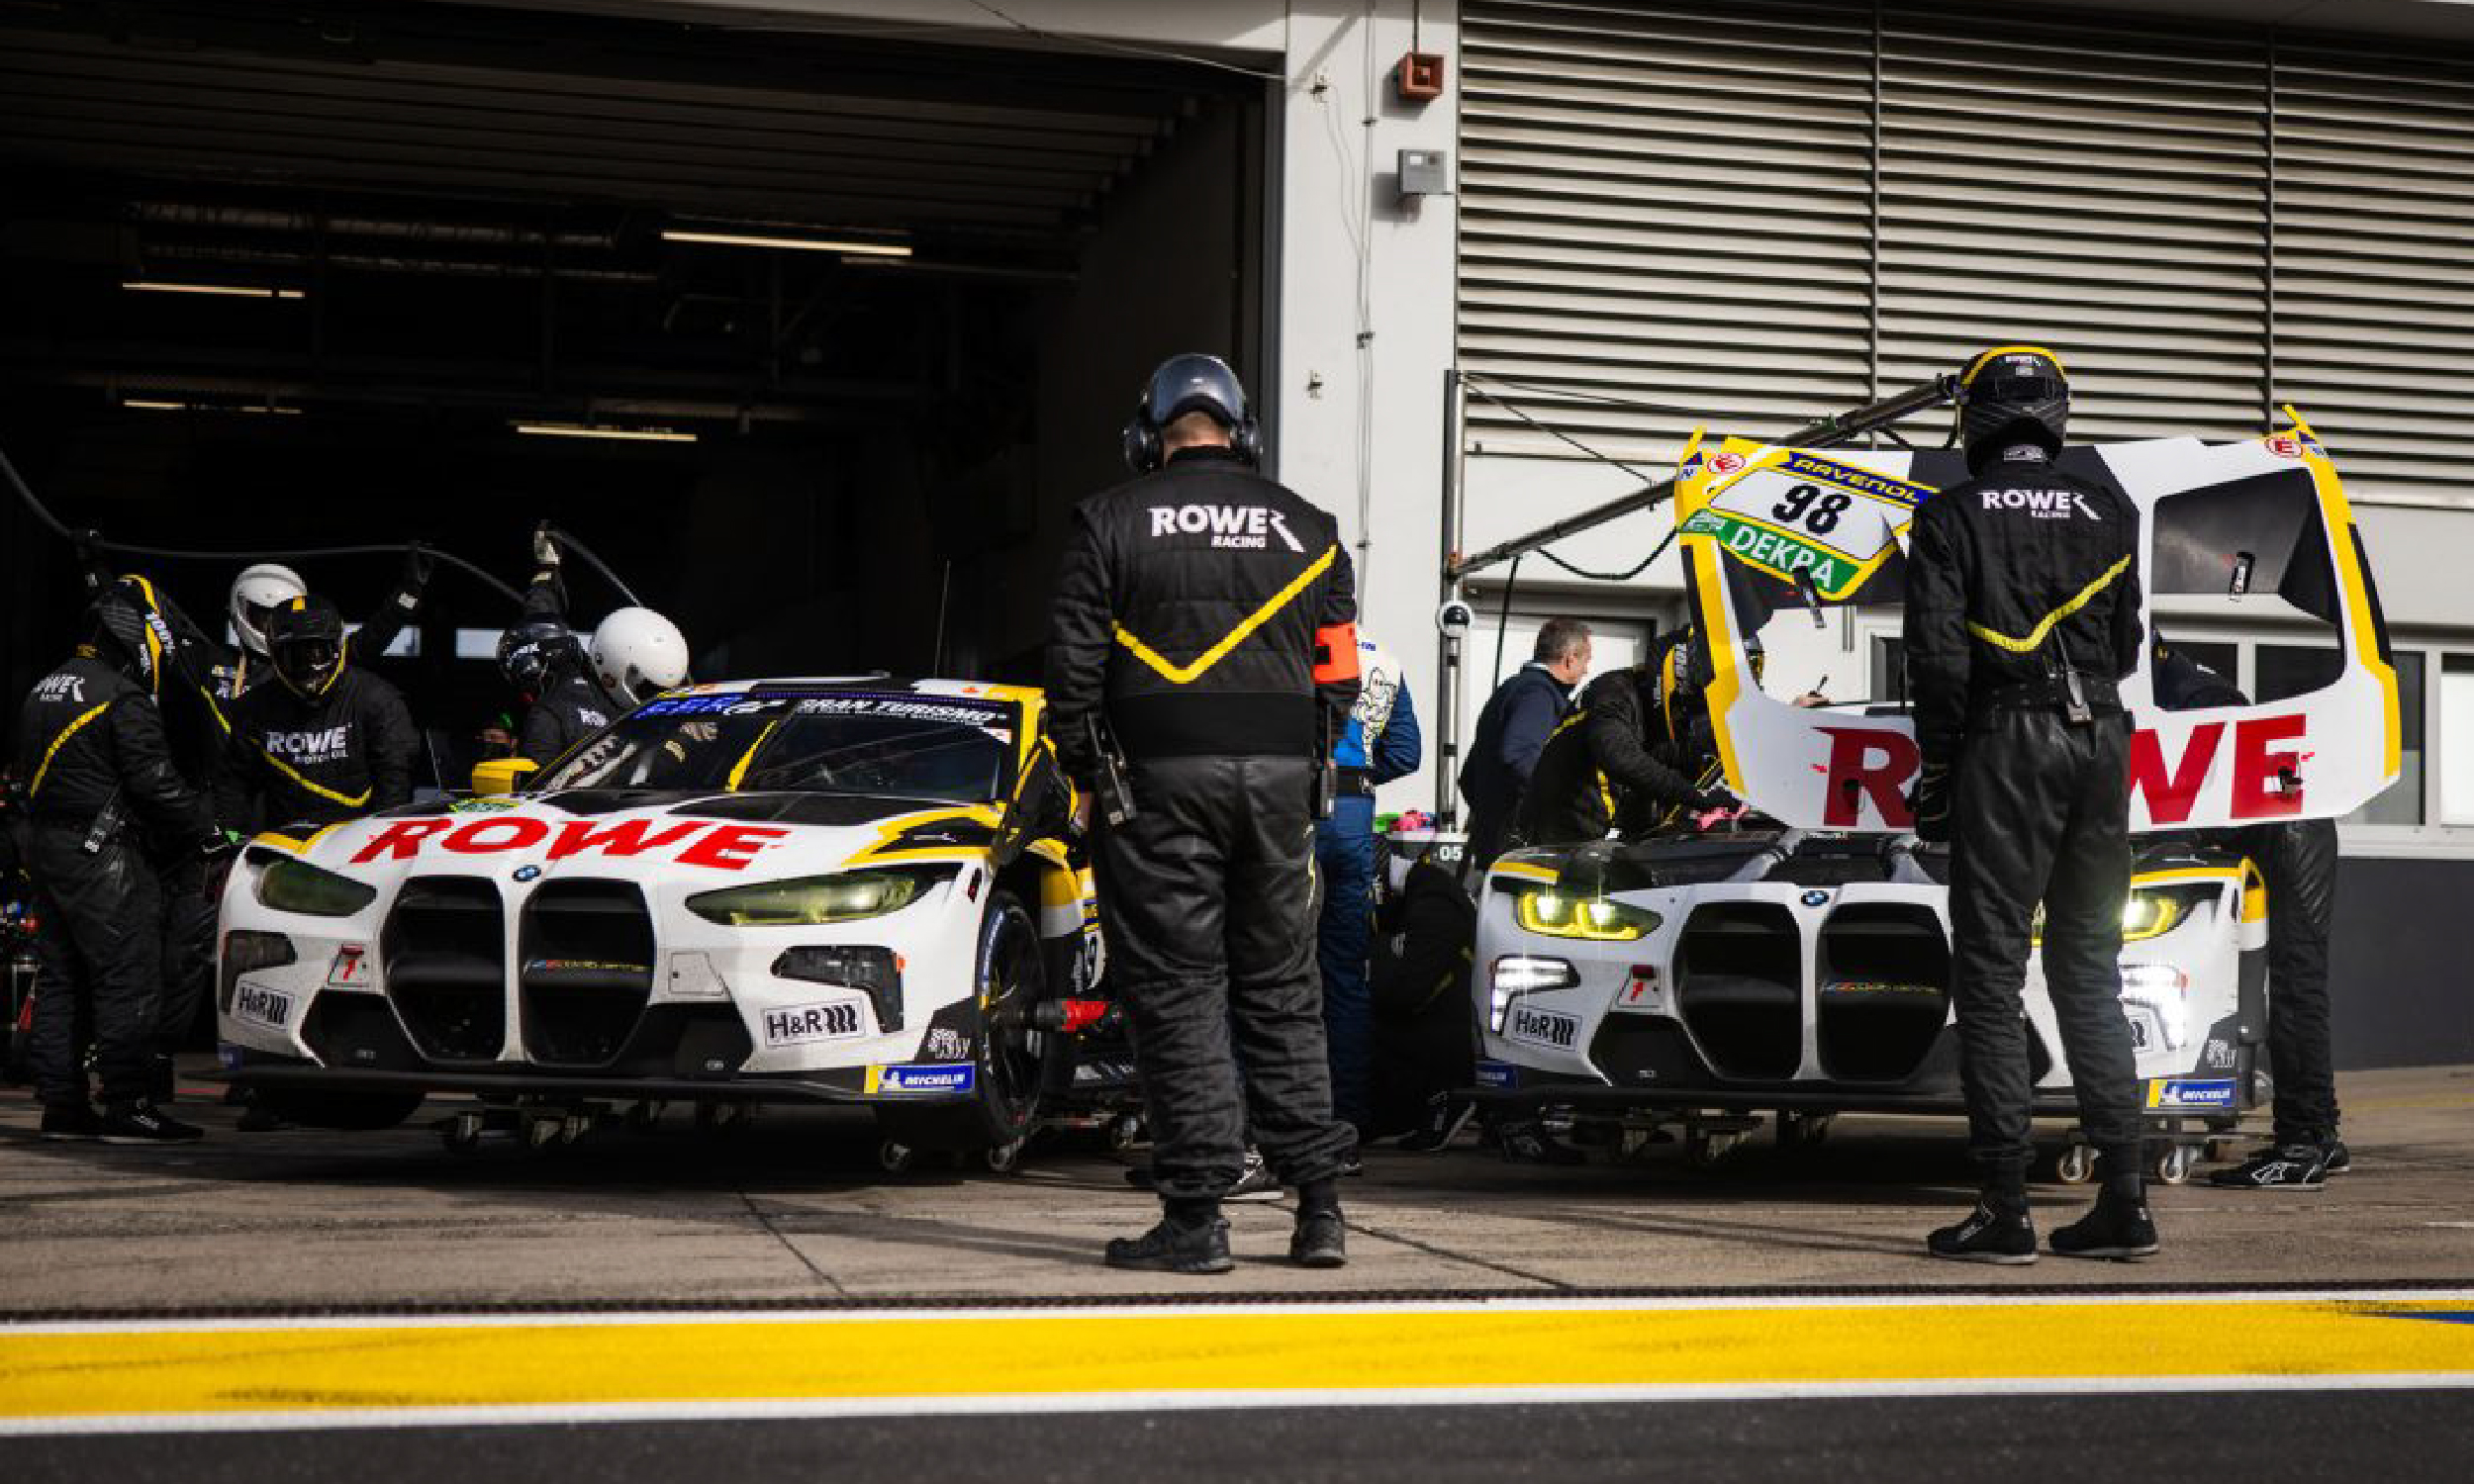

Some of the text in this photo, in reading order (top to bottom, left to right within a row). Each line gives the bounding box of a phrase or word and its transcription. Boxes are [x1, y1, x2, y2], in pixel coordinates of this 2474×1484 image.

[1771, 483, 1853, 533] 98
[1977, 490, 2071, 509] ROWE
[1146, 504, 1268, 536] ROWE
[1210, 535, 1267, 548] RACING
[266, 727, 346, 752] ROWE
[349, 817, 792, 870] ROWE
[767, 1010, 823, 1038] H&R
[1515, 1009, 1551, 1039] H&R
